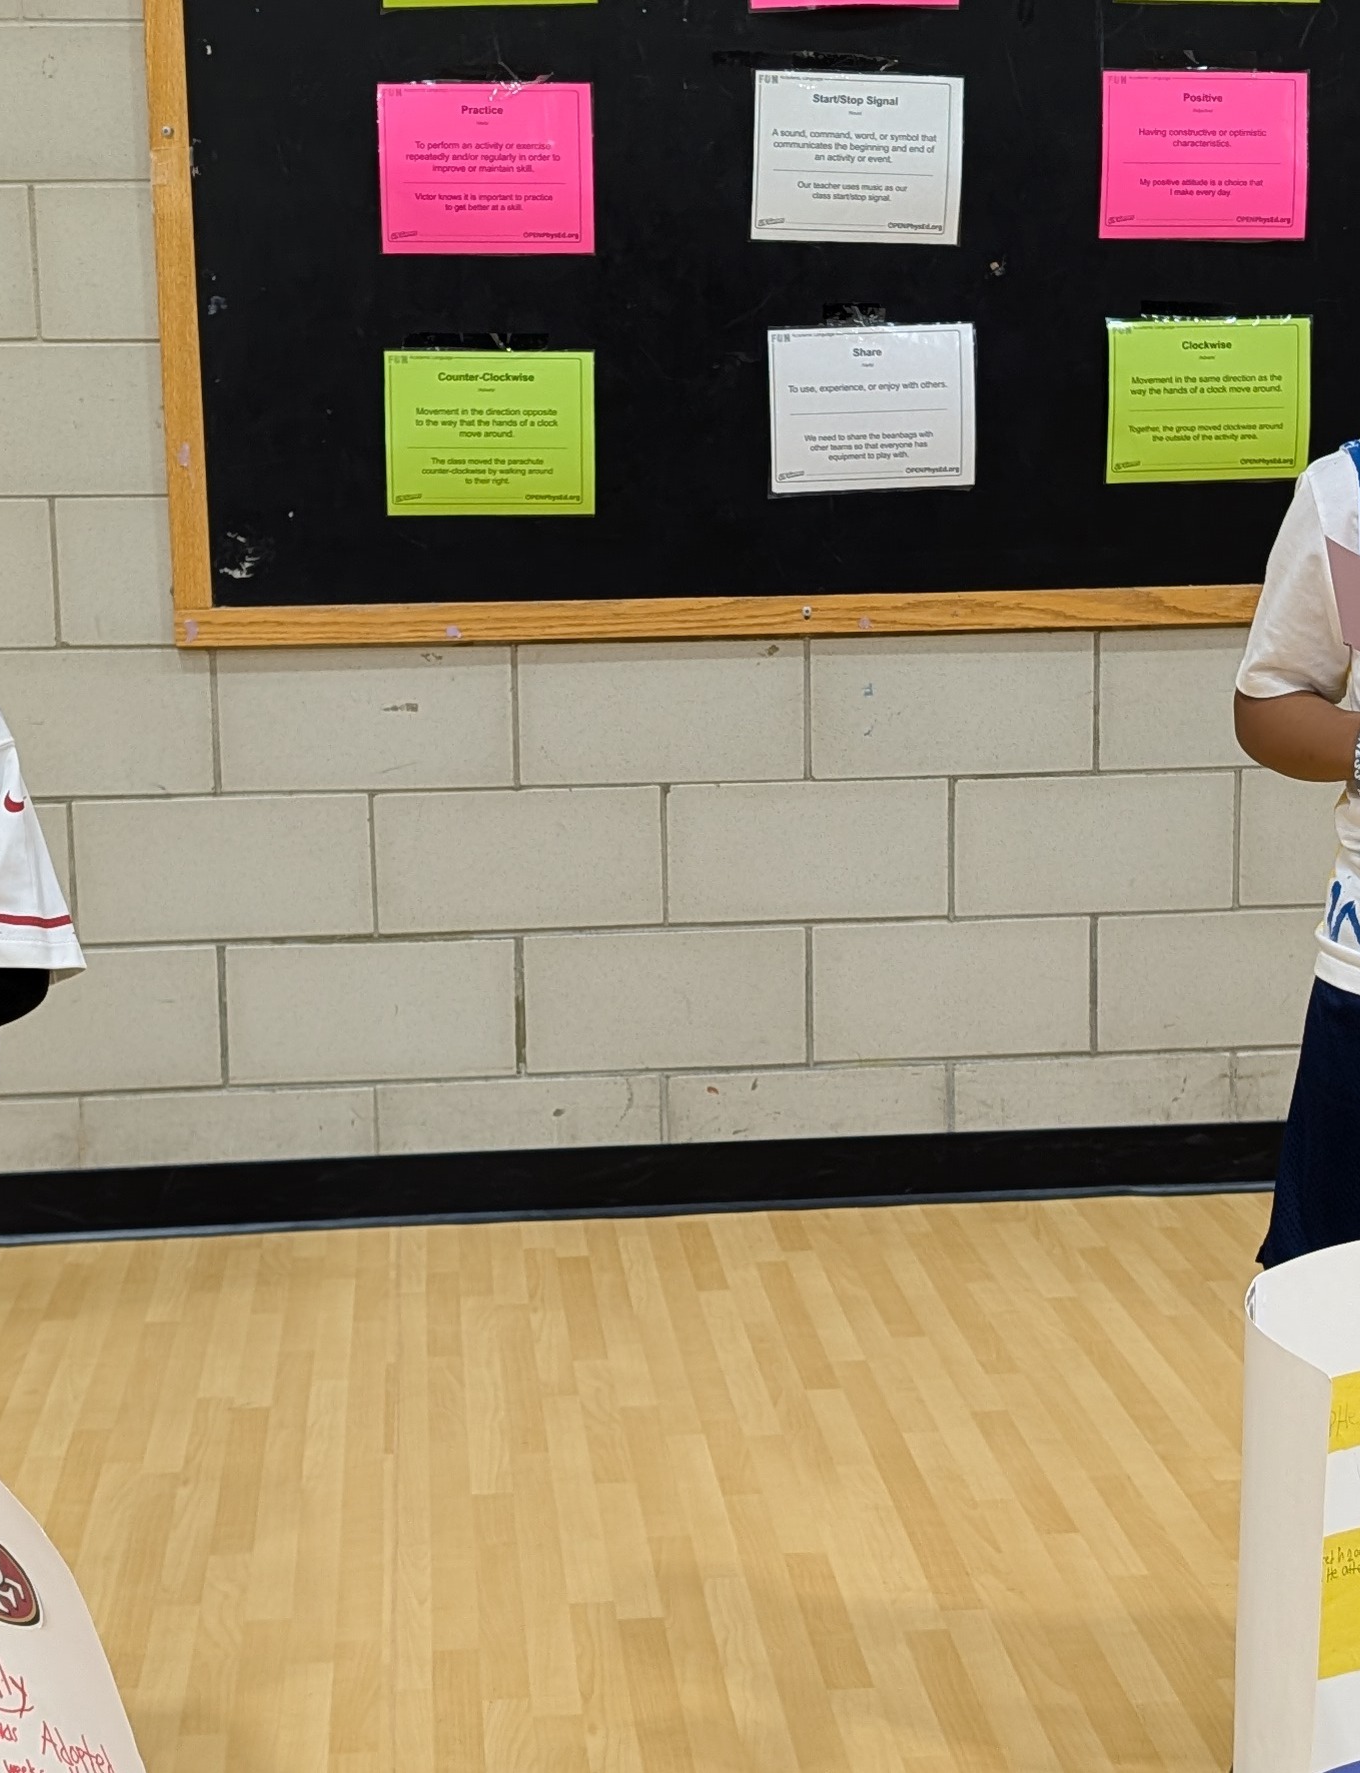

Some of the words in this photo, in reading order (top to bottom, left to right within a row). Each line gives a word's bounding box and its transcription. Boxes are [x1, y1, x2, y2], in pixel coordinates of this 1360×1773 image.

[812, 94, 864, 107] Start/Stop
[866, 95, 899, 108] Signal
[1183, 92, 1223, 102] Positive
[461, 105, 504, 115] Practice
[1181, 340, 1232, 349] Clockwise
[852, 347, 882, 357] Share
[438, 372, 535, 382] Counter-Clockwise
